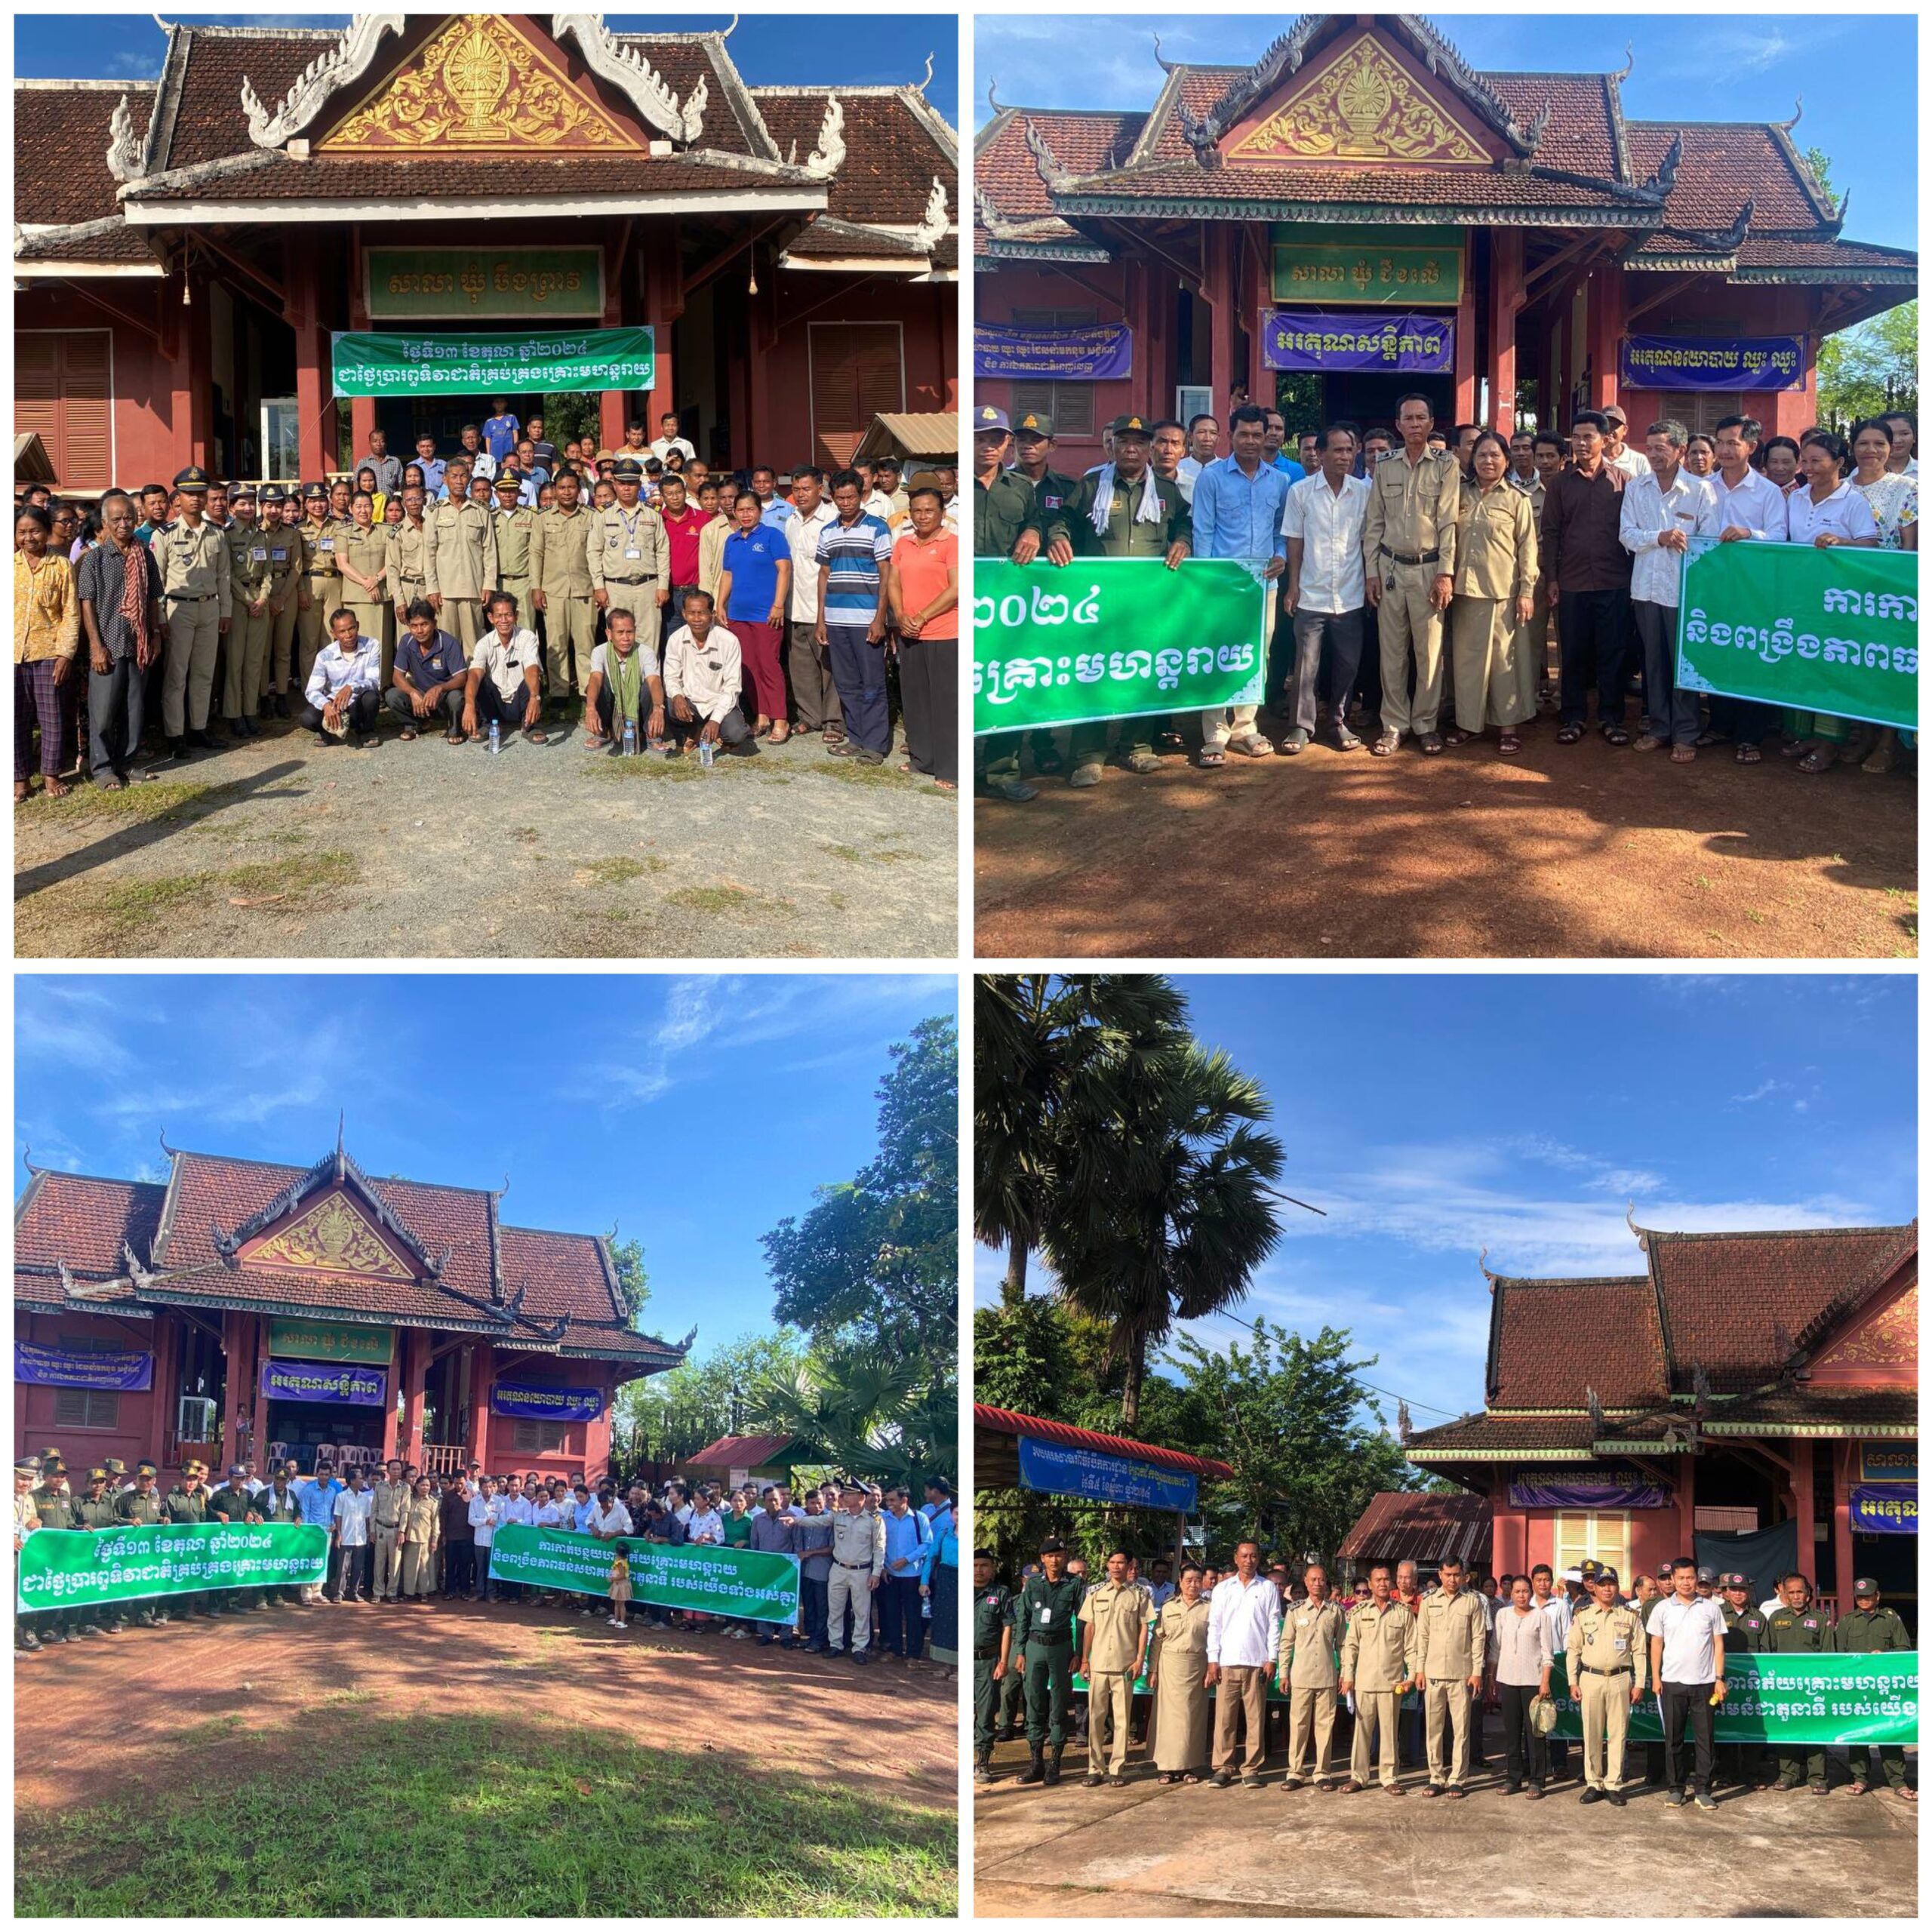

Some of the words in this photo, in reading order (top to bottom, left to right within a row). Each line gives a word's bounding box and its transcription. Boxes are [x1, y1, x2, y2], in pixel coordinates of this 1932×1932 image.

[389, 272, 454, 294] សាលា
[460, 263, 486, 303] ឃុំ
[1291, 266, 1346, 281] សាលា
[1352, 259, 1374, 291] ឃុំ
[401, 340, 457, 364] ថ្ងៃទី១៣
[462, 342, 514, 363] ខែតុលា
[519, 339, 587, 362] ឆ្នាំ២០២៤
[1276, 325, 1441, 361] អរគុណសន្តិភាព
[1630, 349, 1740, 374] អរគុណនយោបាយ
[1743, 351, 1767, 374] ឈ្នះ
[1771, 351, 1796, 374] ឈ្នះ
[270, 1374, 377, 1397] អរគុណសន្តិភាព
[94, 1534, 150, 1564] ថ្ងៃទី១៣
[155, 1534, 206, 1558] ខែតុលា
[209, 1530, 272, 1557] ឆ្នាំ២០២៤
